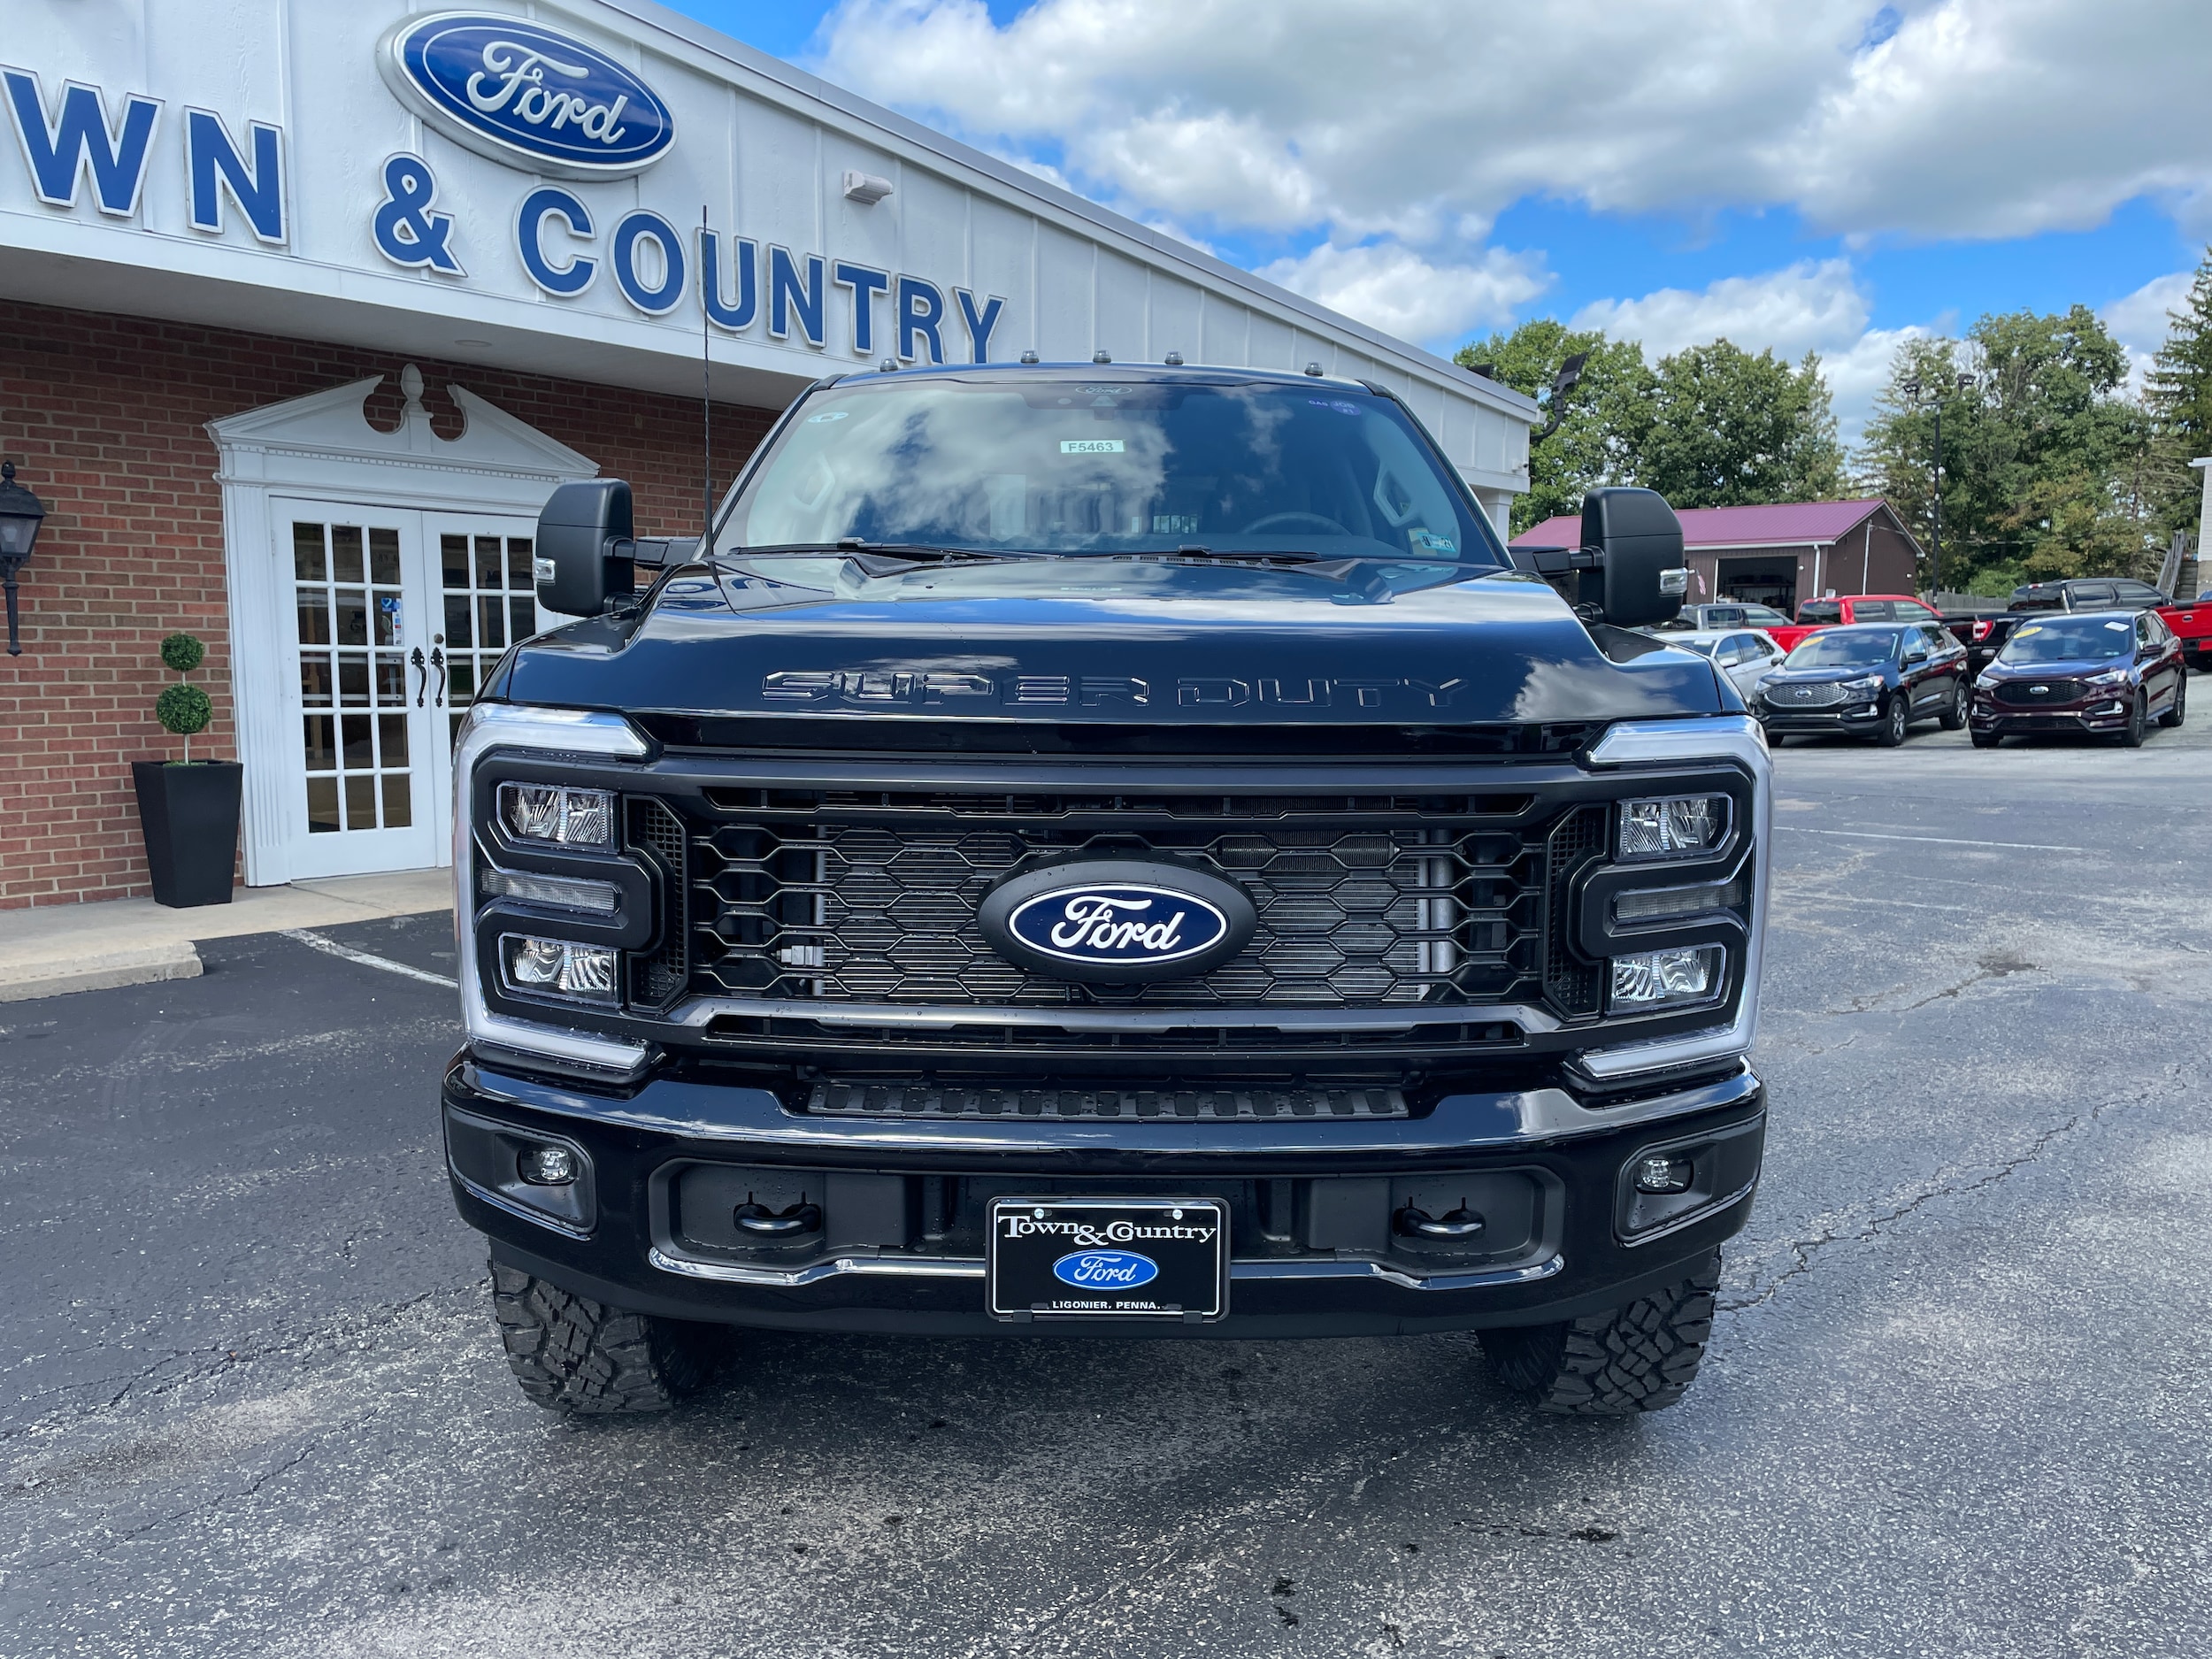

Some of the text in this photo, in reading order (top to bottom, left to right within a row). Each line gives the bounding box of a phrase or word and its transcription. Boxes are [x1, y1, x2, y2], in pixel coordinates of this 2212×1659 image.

[465, 41, 630, 145] Ford
[370, 150, 469, 279] &
[513, 184, 1008, 365] COUNTRY
[1068, 442, 1115, 452] F5463
[762, 670, 1470, 708] SUPER DUTY
[1050, 895, 1186, 950] Ford
[1073, 1255, 1138, 1282] Ford
[1116, 1301, 1161, 1310] PENNA.
